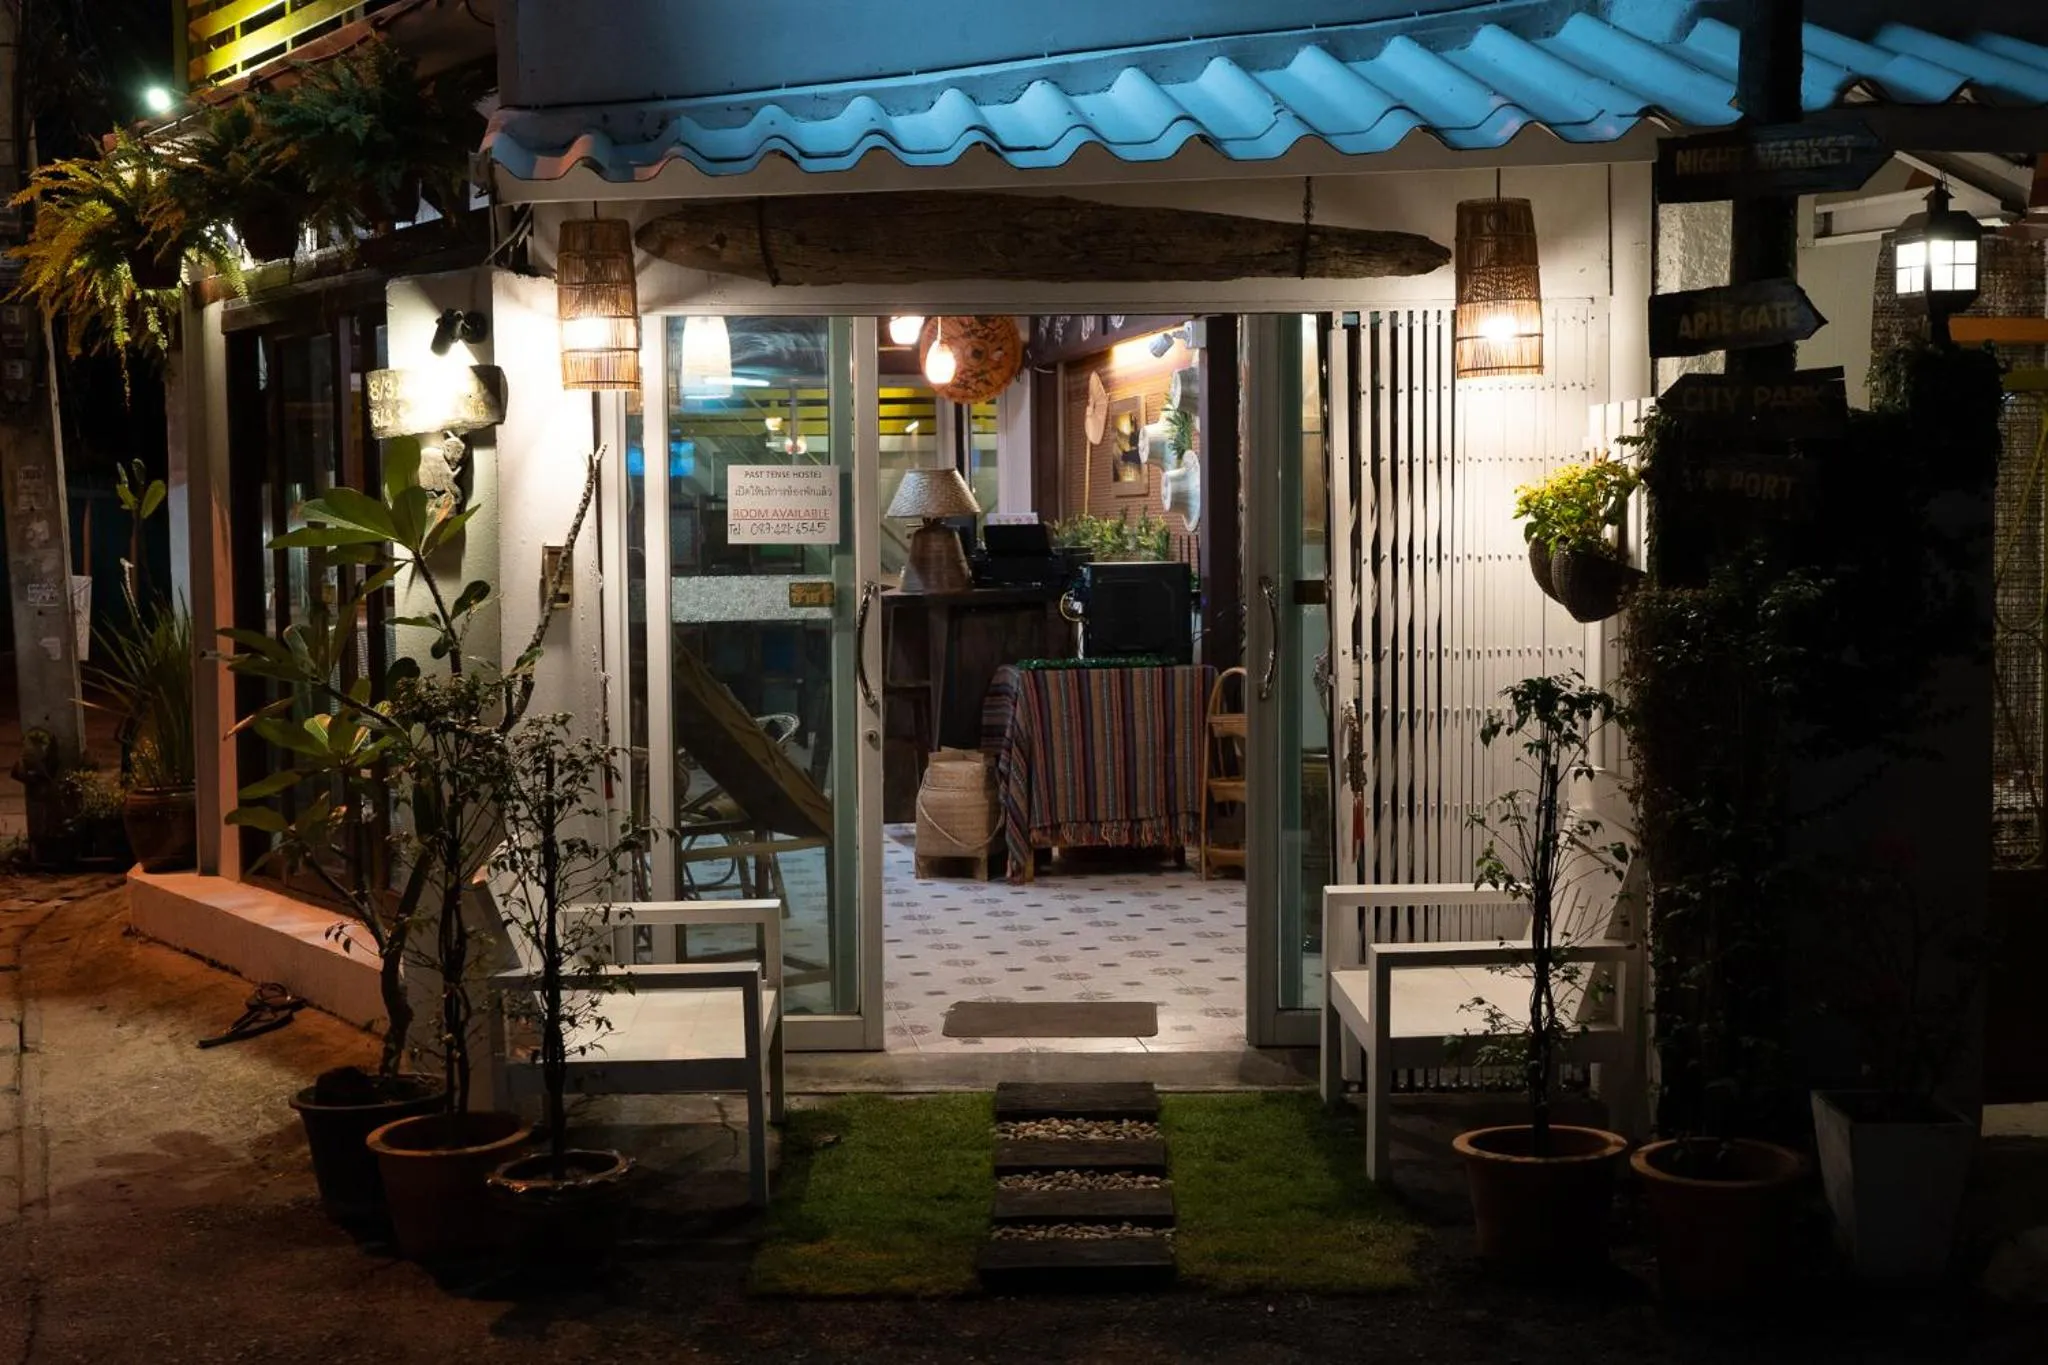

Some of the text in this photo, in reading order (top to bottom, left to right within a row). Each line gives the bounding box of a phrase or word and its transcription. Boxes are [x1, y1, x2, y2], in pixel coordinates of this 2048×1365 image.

[1676, 135, 1855, 176] NIGHT MARKET
[1738, 300, 1798, 333] GATE
[1682, 384, 1825, 413] CITY PARK
[744, 470, 822, 479] PAST TENSE HOSTEL
[733, 508, 830, 519] ROOM AVAILABLE
